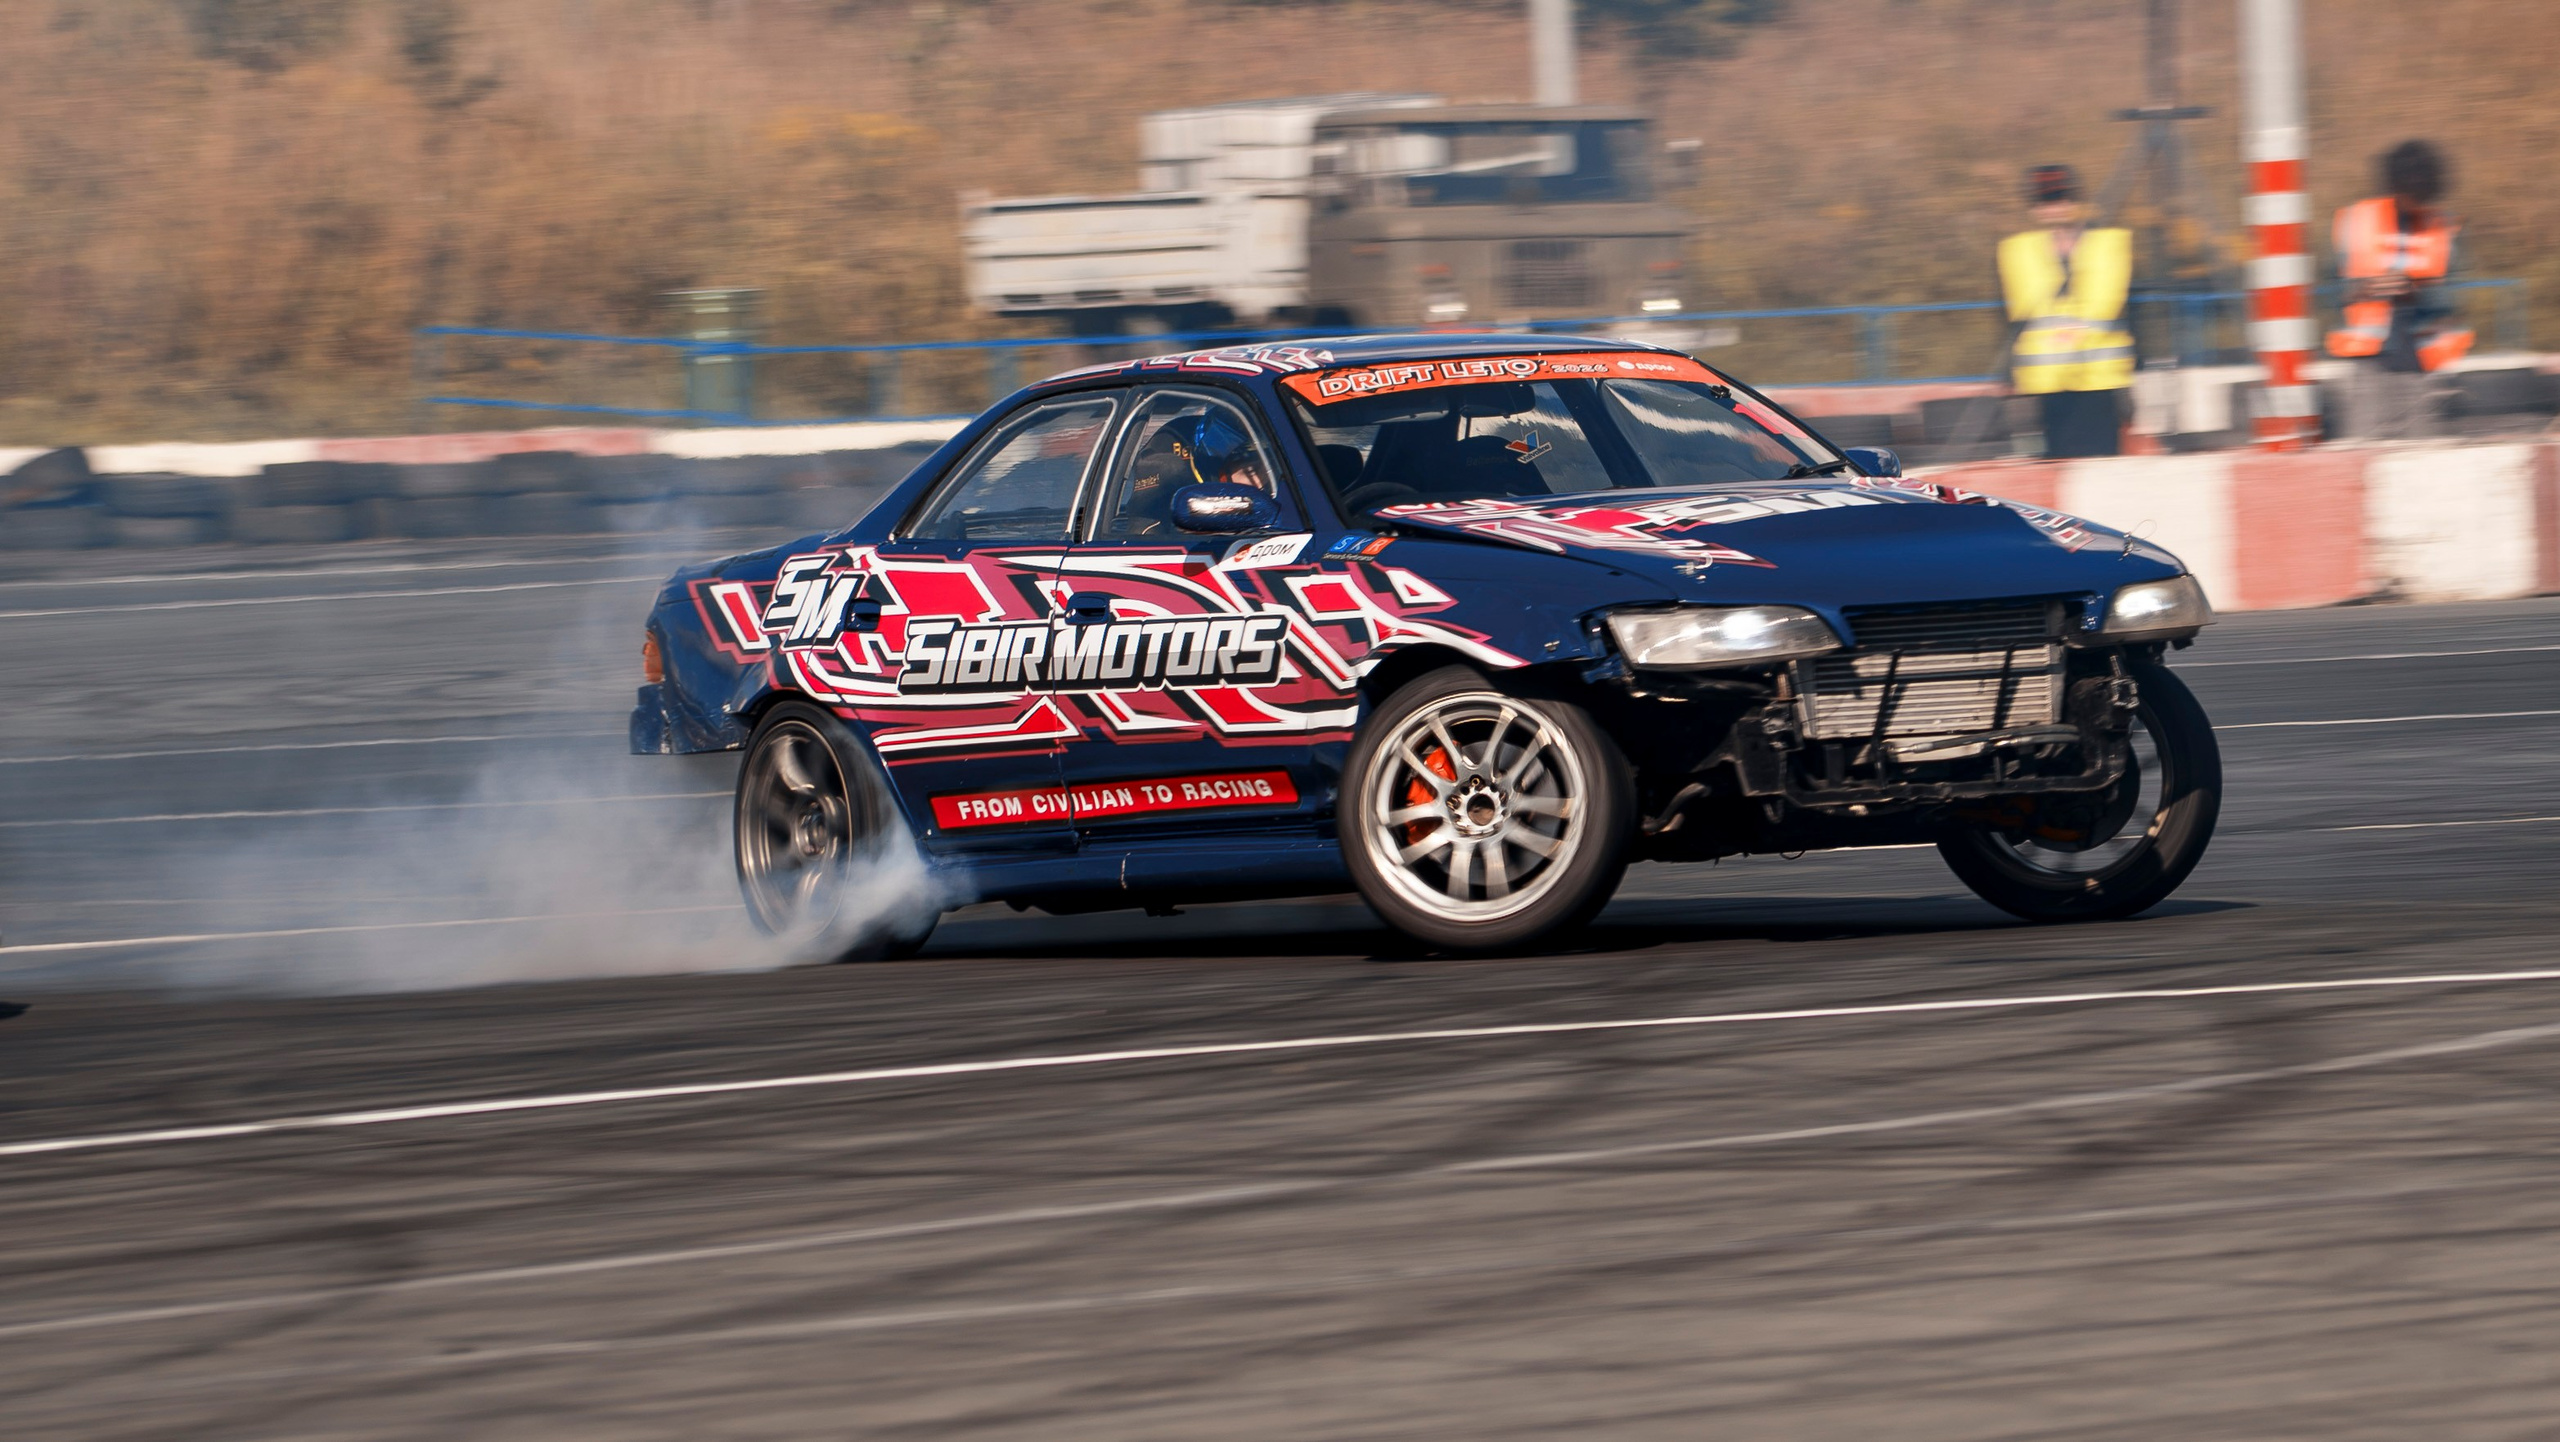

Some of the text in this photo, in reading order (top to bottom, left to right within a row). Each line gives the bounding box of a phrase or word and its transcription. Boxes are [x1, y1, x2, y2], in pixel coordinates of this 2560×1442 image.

[1319, 364, 1434, 397] DRIFT
[1334, 536, 1389, 553] SKR
[765, 557, 861, 643] SM
[900, 617, 1284, 686] SIBIR MOTORS
[957, 778, 1274, 820] FROM CIVILIAN TO RACING
